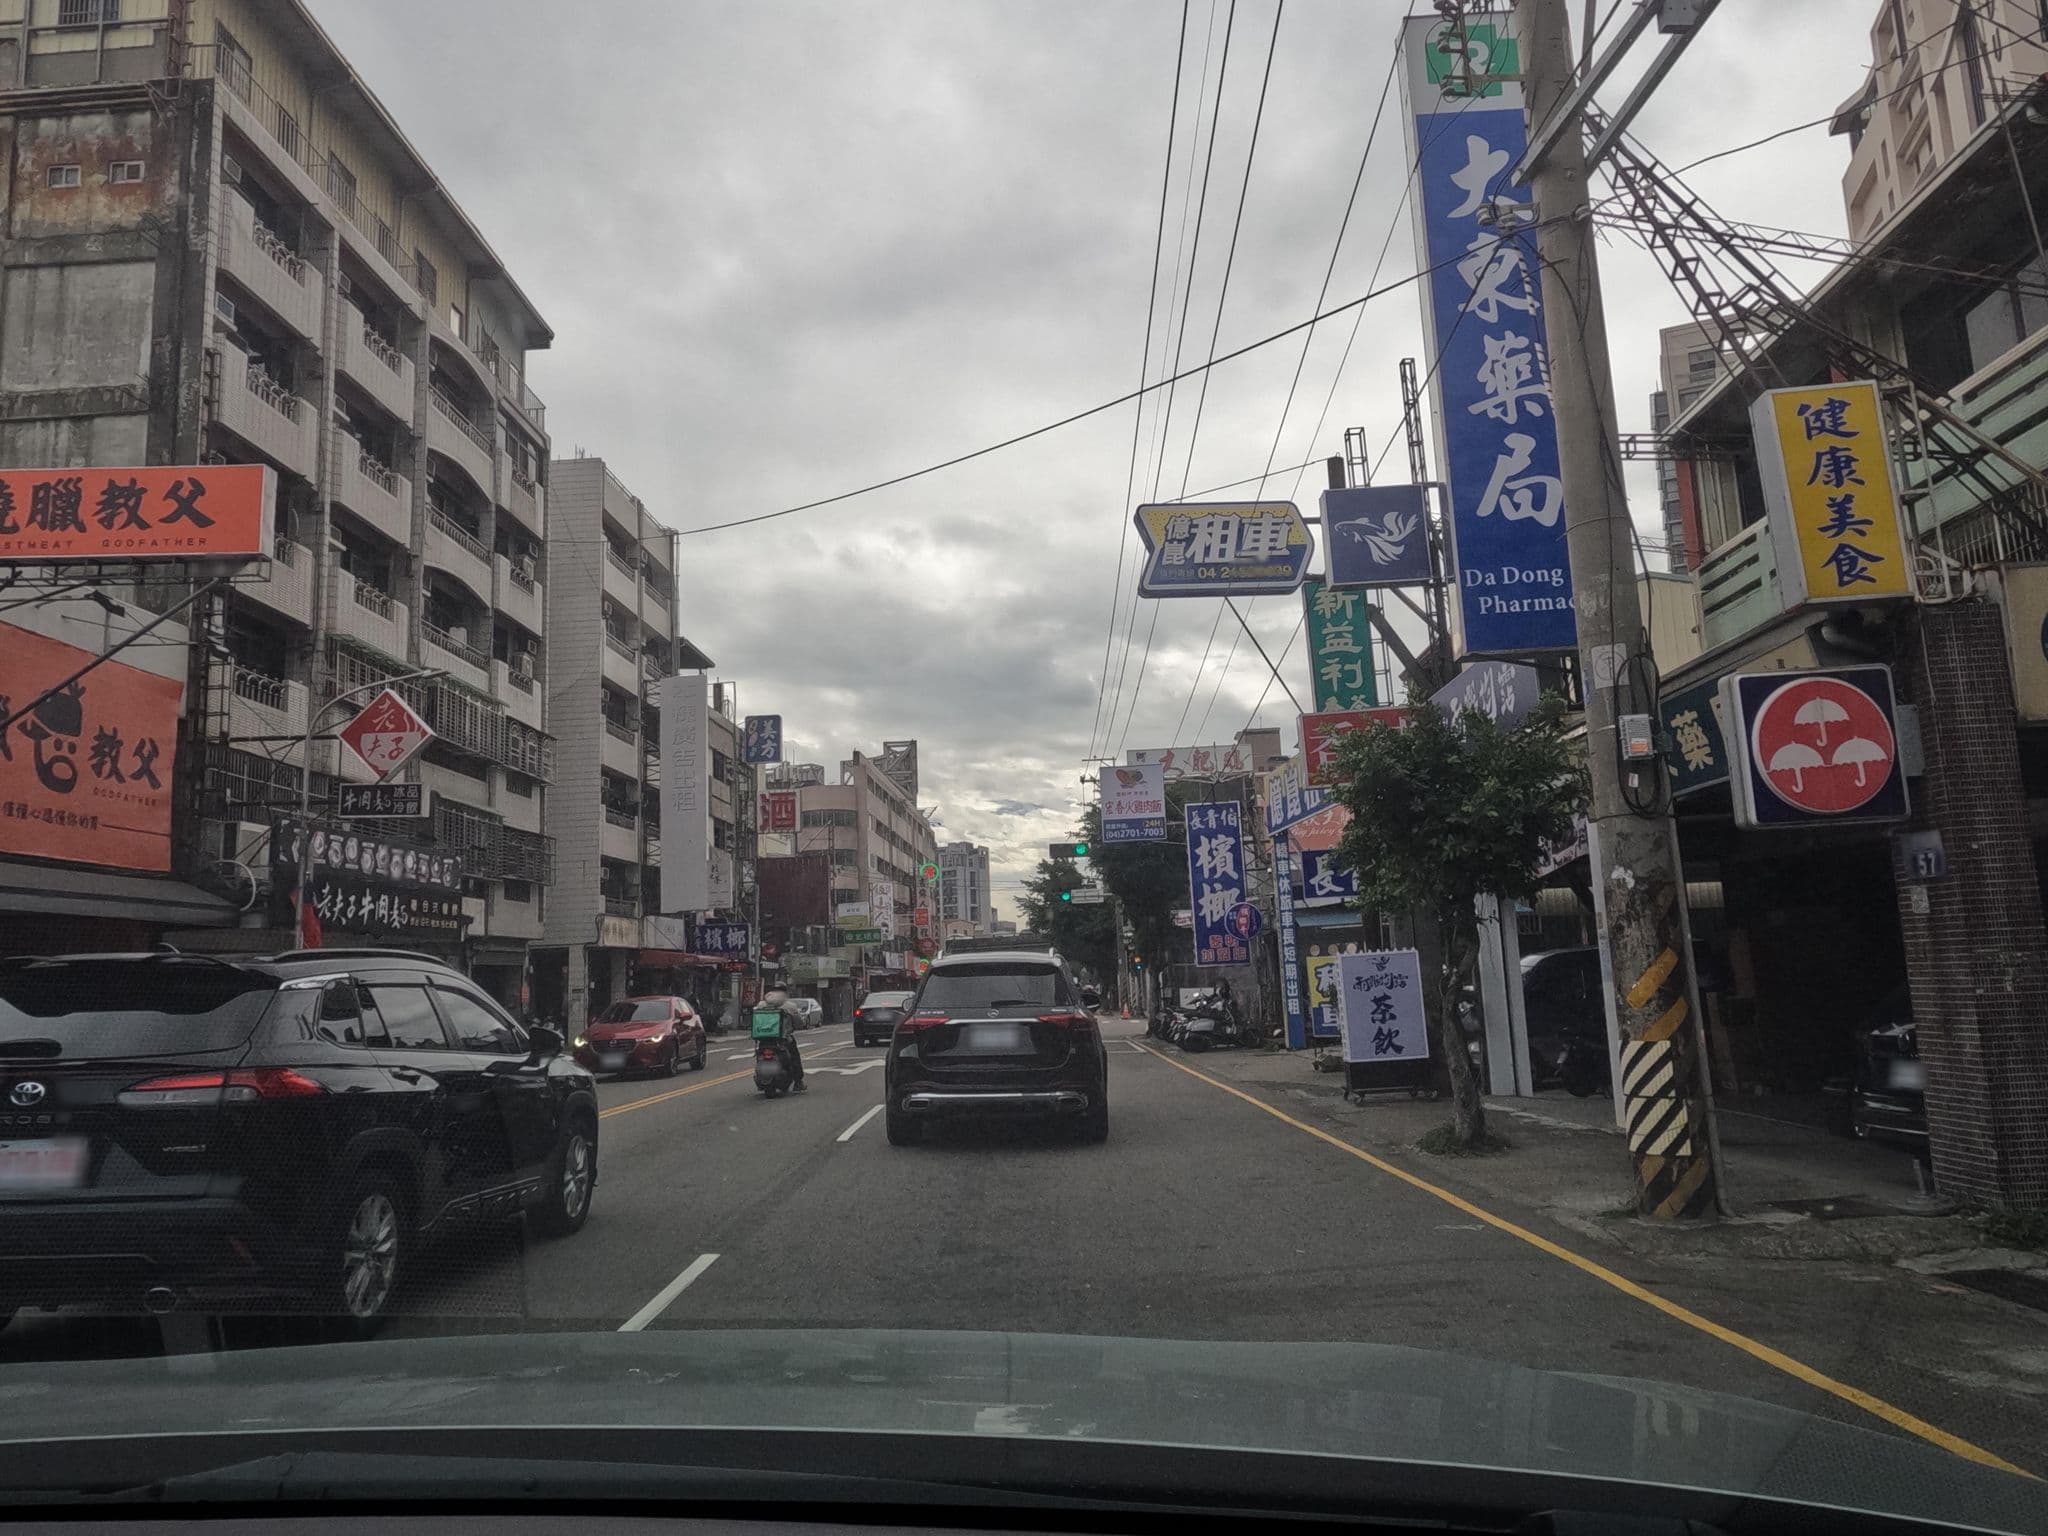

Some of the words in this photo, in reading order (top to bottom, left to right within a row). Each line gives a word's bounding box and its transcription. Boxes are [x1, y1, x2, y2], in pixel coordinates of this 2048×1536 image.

[1446, 135, 1563, 528] 大東藥局
[1796, 397, 1885, 588] 健康美食
[102, 537, 208, 548] GODFATHER
[1186, 512, 1294, 564] 租車
[1463, 568, 1497, 588] Da
[1501, 566, 1564, 588] Dong
[1312, 587, 1364, 693] 新益利
[88, 724, 162, 790] 教父
[1194, 833, 1241, 928] 檳榔
[1370, 993, 1405, 1055] 茶飲
